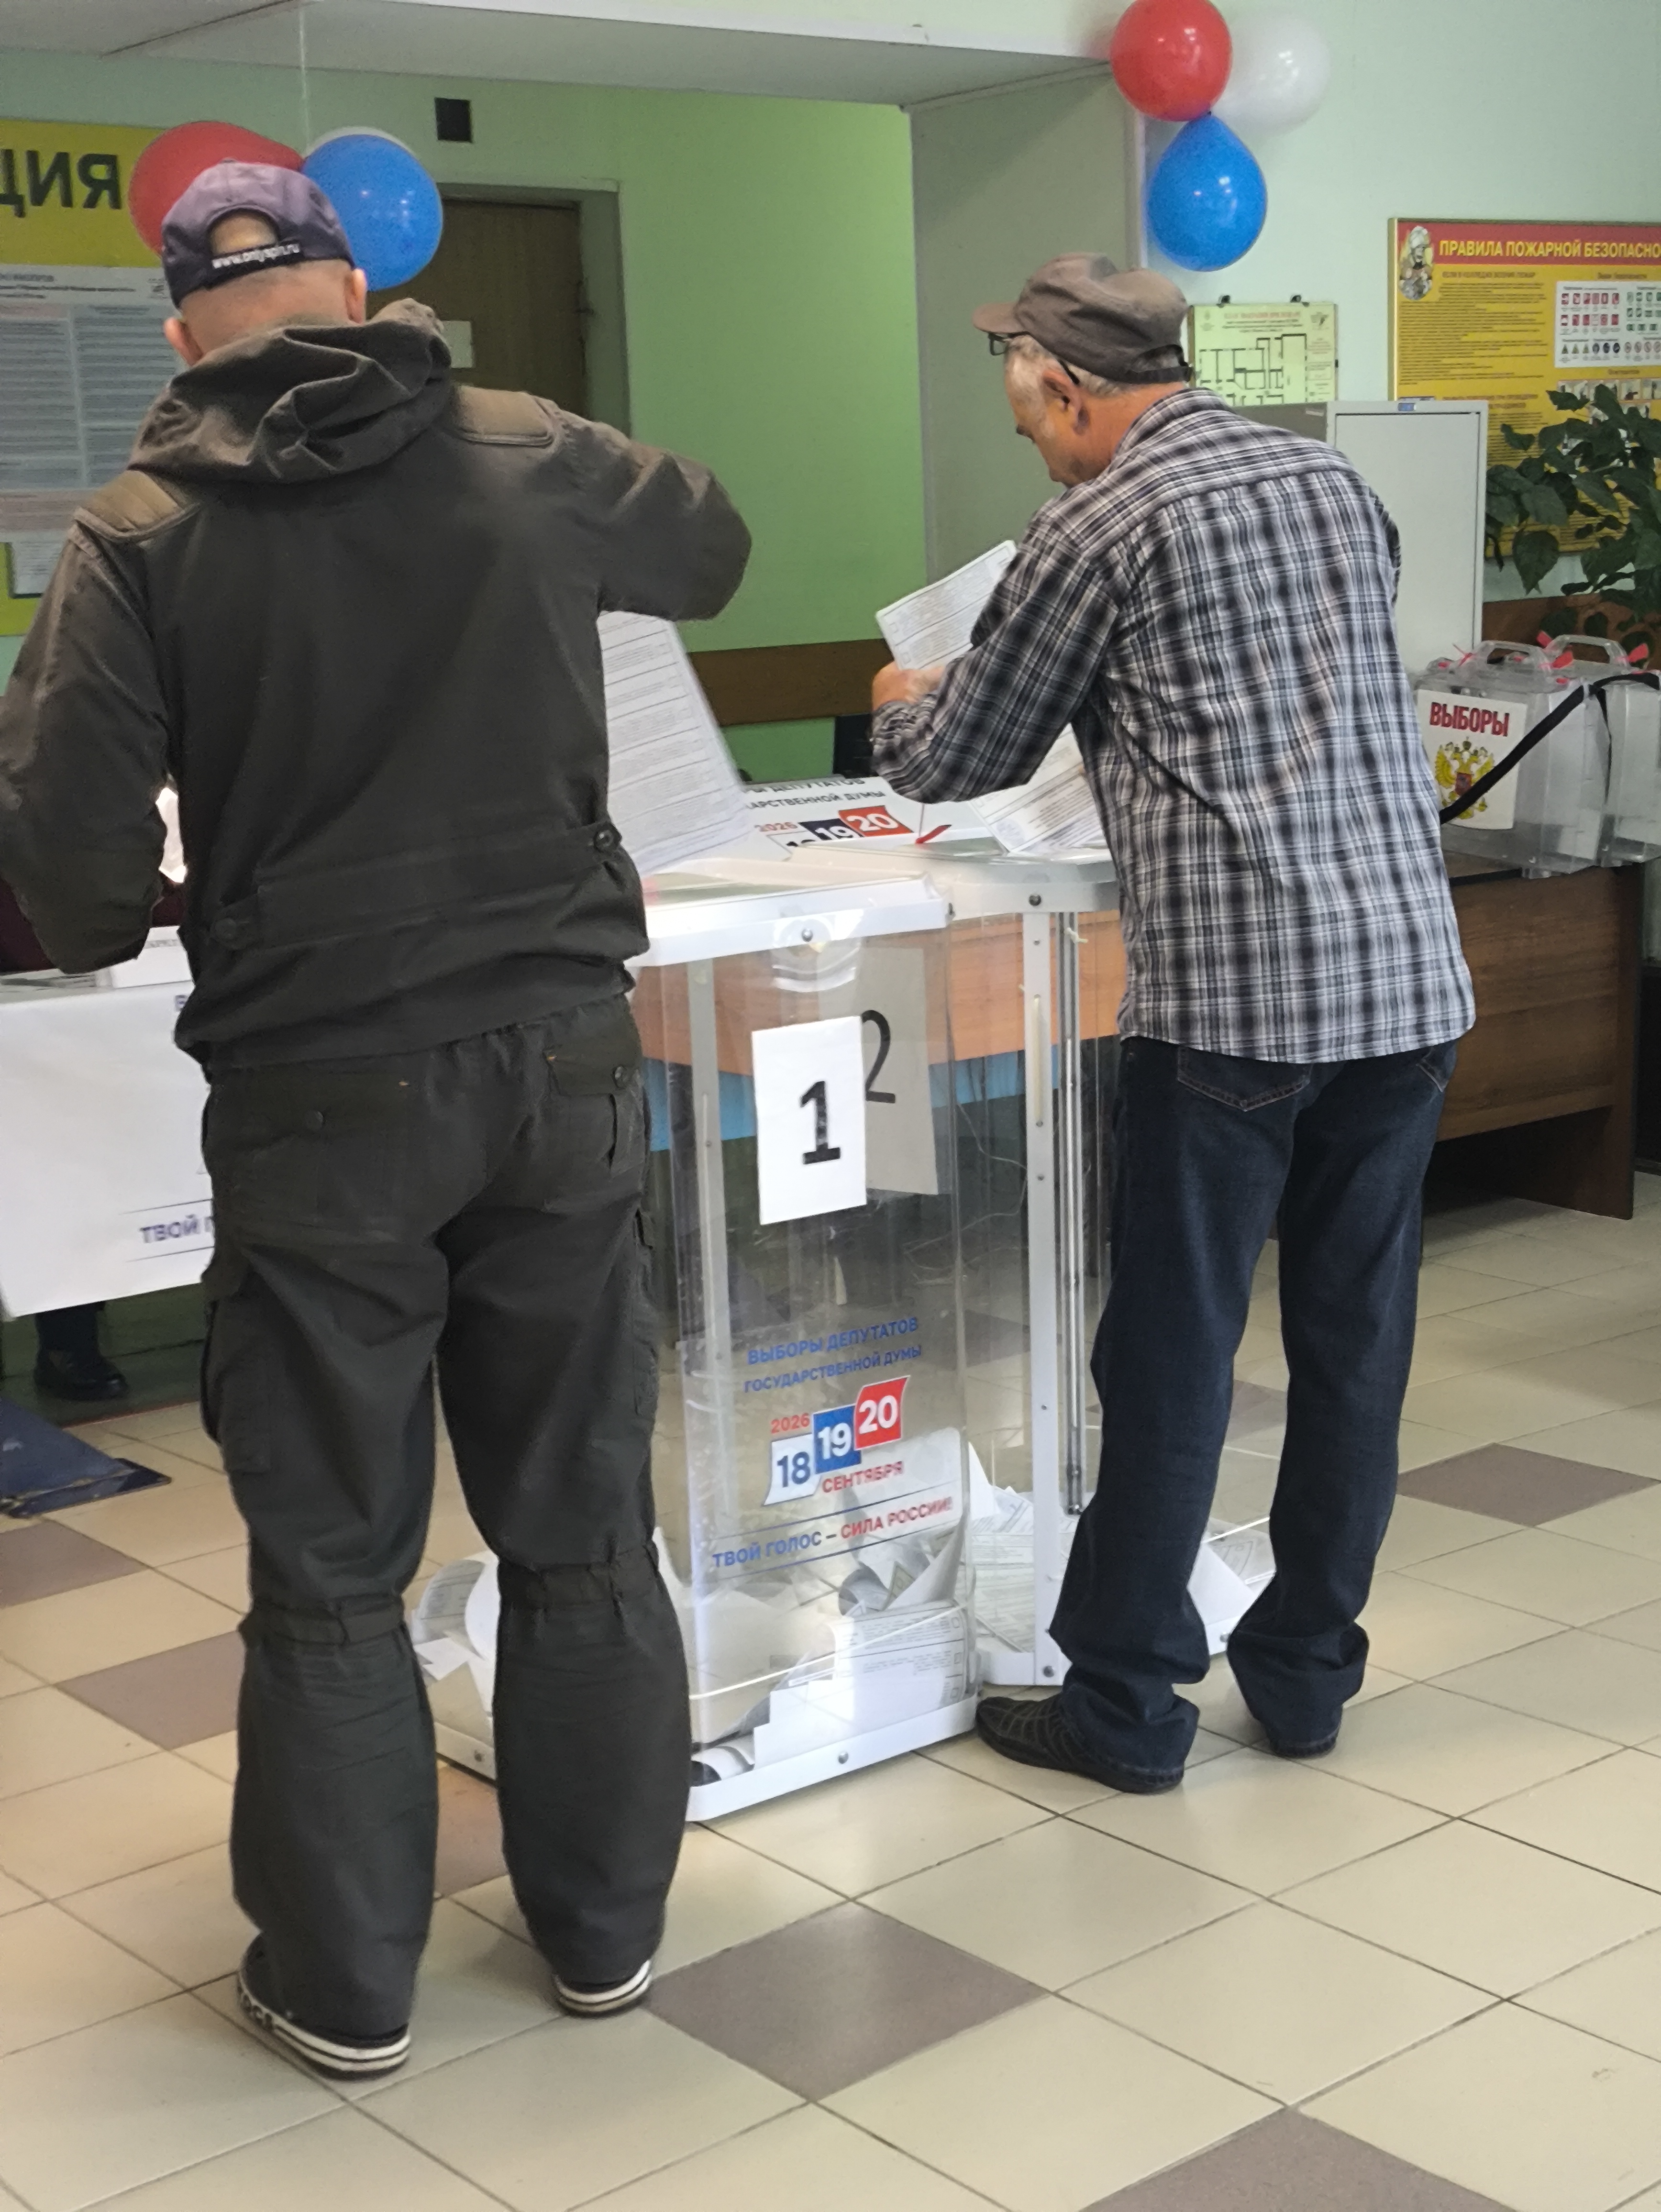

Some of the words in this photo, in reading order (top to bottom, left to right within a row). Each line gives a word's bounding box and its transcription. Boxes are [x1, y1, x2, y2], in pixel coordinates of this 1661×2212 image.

[1439, 240, 1503, 256] ПРАВИЛА
[1506, 239, 1582, 257] ПОЖАРНОЙ
[1584, 242, 1661, 258] БЕЗОПАСНО
[1429, 701, 1510, 737] ВЫБОРЫ
[754, 821, 798, 832] 2026
[846, 813, 898, 831] 20
[862, 1009, 896, 1104] 2
[799, 1080, 841, 1165] 1
[140, 1214, 201, 1244] ТВОЙ
[747, 1336, 823, 1365] ВЫБОРЫ
[826, 1316, 918, 1351] ДЕПУТАТОВ
[744, 1350, 881, 1393] ГОСУДАРСТВЕННОЙ
[884, 1344, 922, 1366] ДУМЫ
[770, 1412, 810, 1434] 2026
[859, 1395, 898, 1435] 20
[818, 1422, 853, 1460] 19
[777, 1451, 811, 1488] 18
[821, 1460, 903, 1493] СЕНТЯБРЯ
[712, 1542, 761, 1568] ТВОЙ
[766, 1531, 822, 1556] ГОЛОС
[841, 1515, 884, 1539] СИЛА
